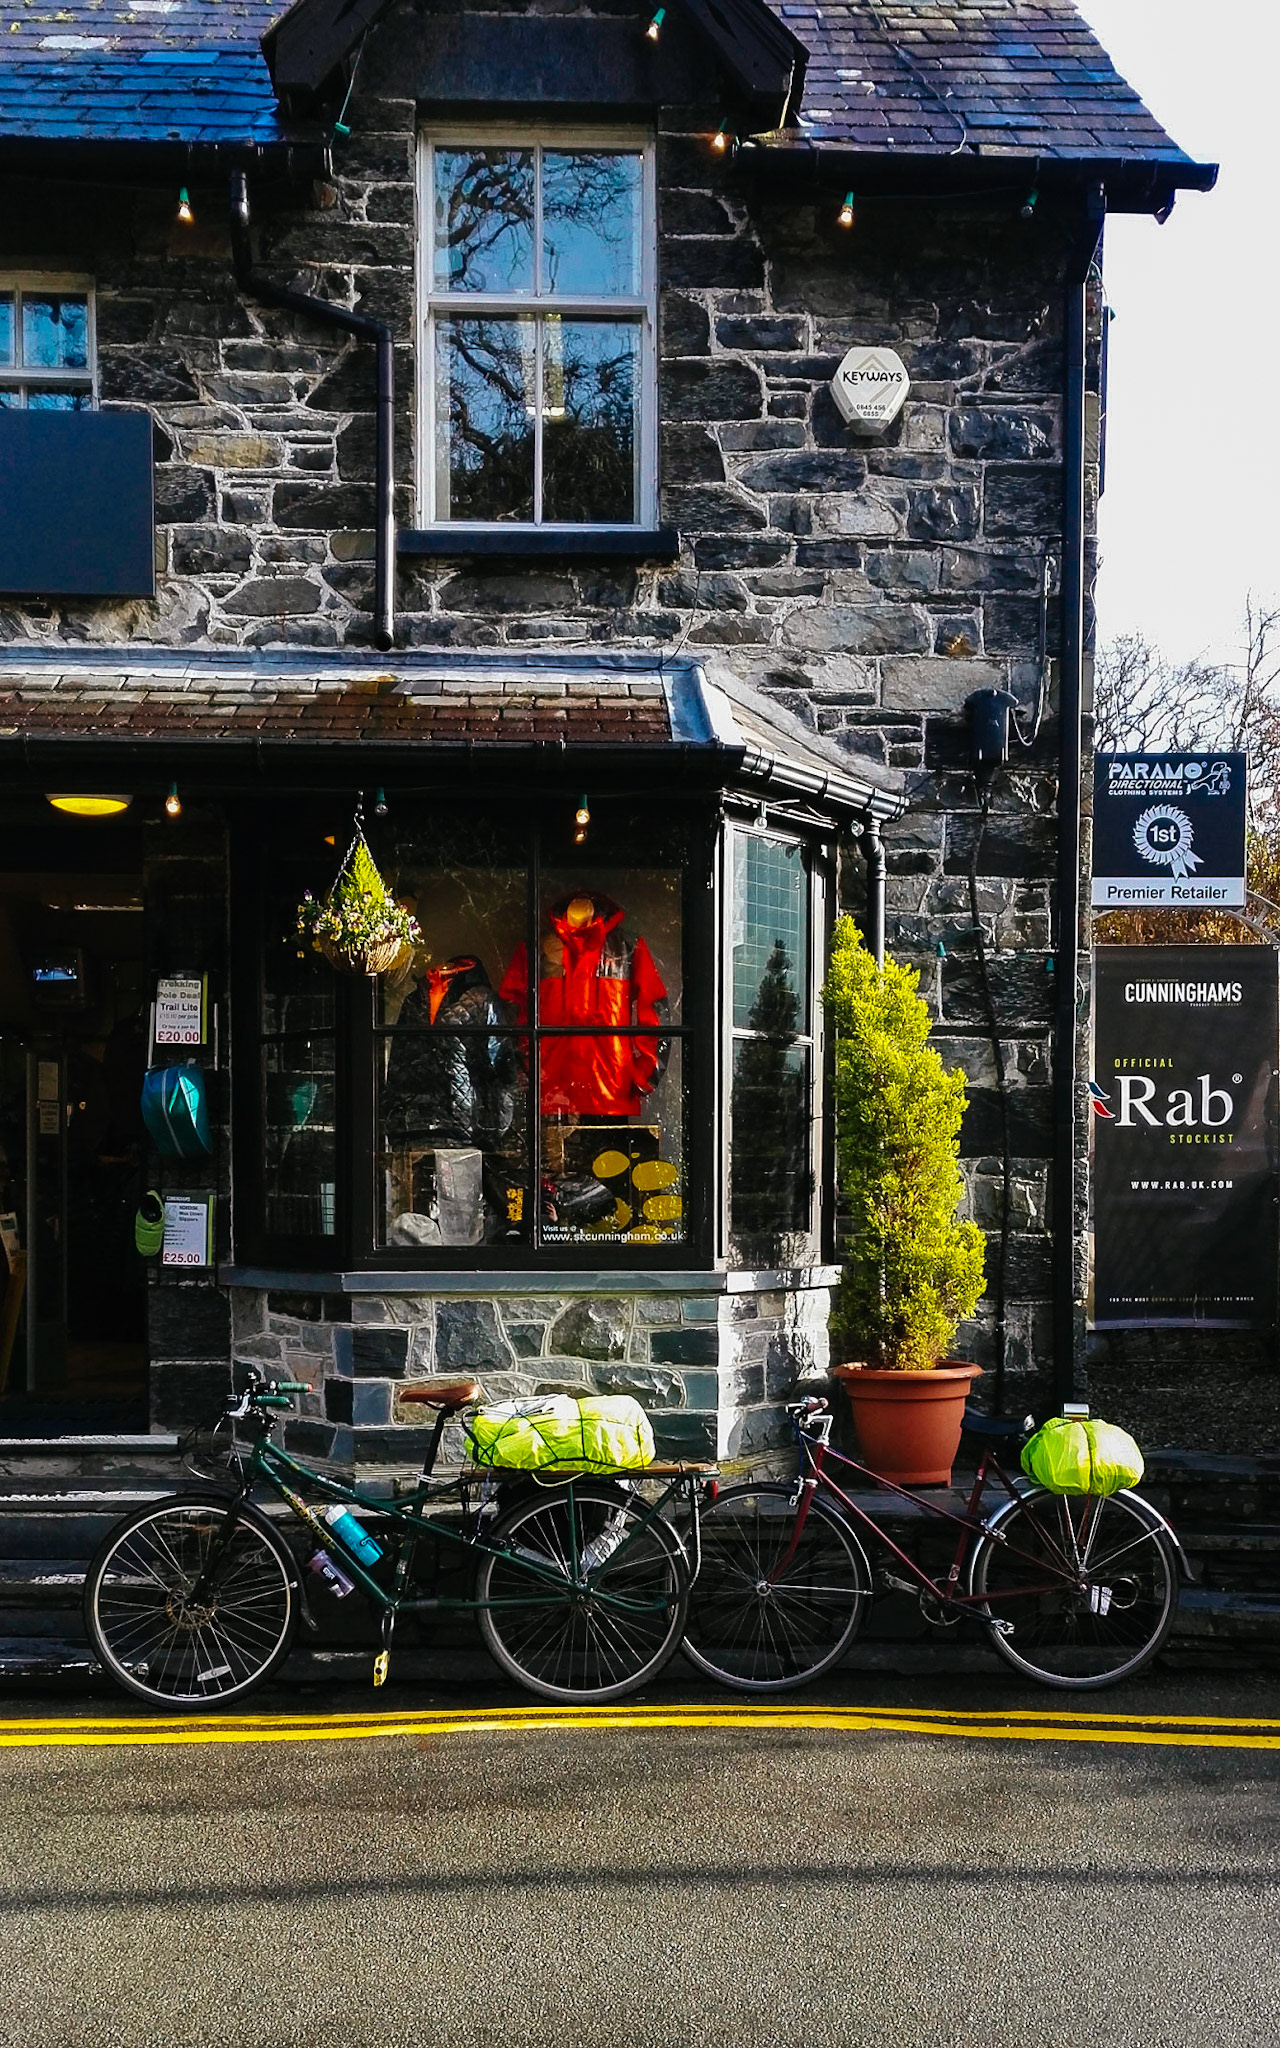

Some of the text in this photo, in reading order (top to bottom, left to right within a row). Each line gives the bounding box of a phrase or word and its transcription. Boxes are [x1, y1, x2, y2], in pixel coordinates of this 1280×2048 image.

[843, 371, 902, 385] KEYWAYS
[1108, 762, 1202, 779] PARAMO
[1108, 780, 1183, 789] DIRECTIONAL
[1150, 825, 1177, 842] 1st
[1107, 886, 1228, 899] Premier Retailer
[160, 1003, 198, 1011] Trail Lite
[157, 1030, 199, 1042] £20.00
[1114, 1058, 1174, 1068] OFFICIAL
[1169, 1134, 1234, 1144] STOCKIST
[1131, 1180, 1233, 1190] WWW.RAB.UK.COM
[164, 1252, 200, 1263] £25.00
